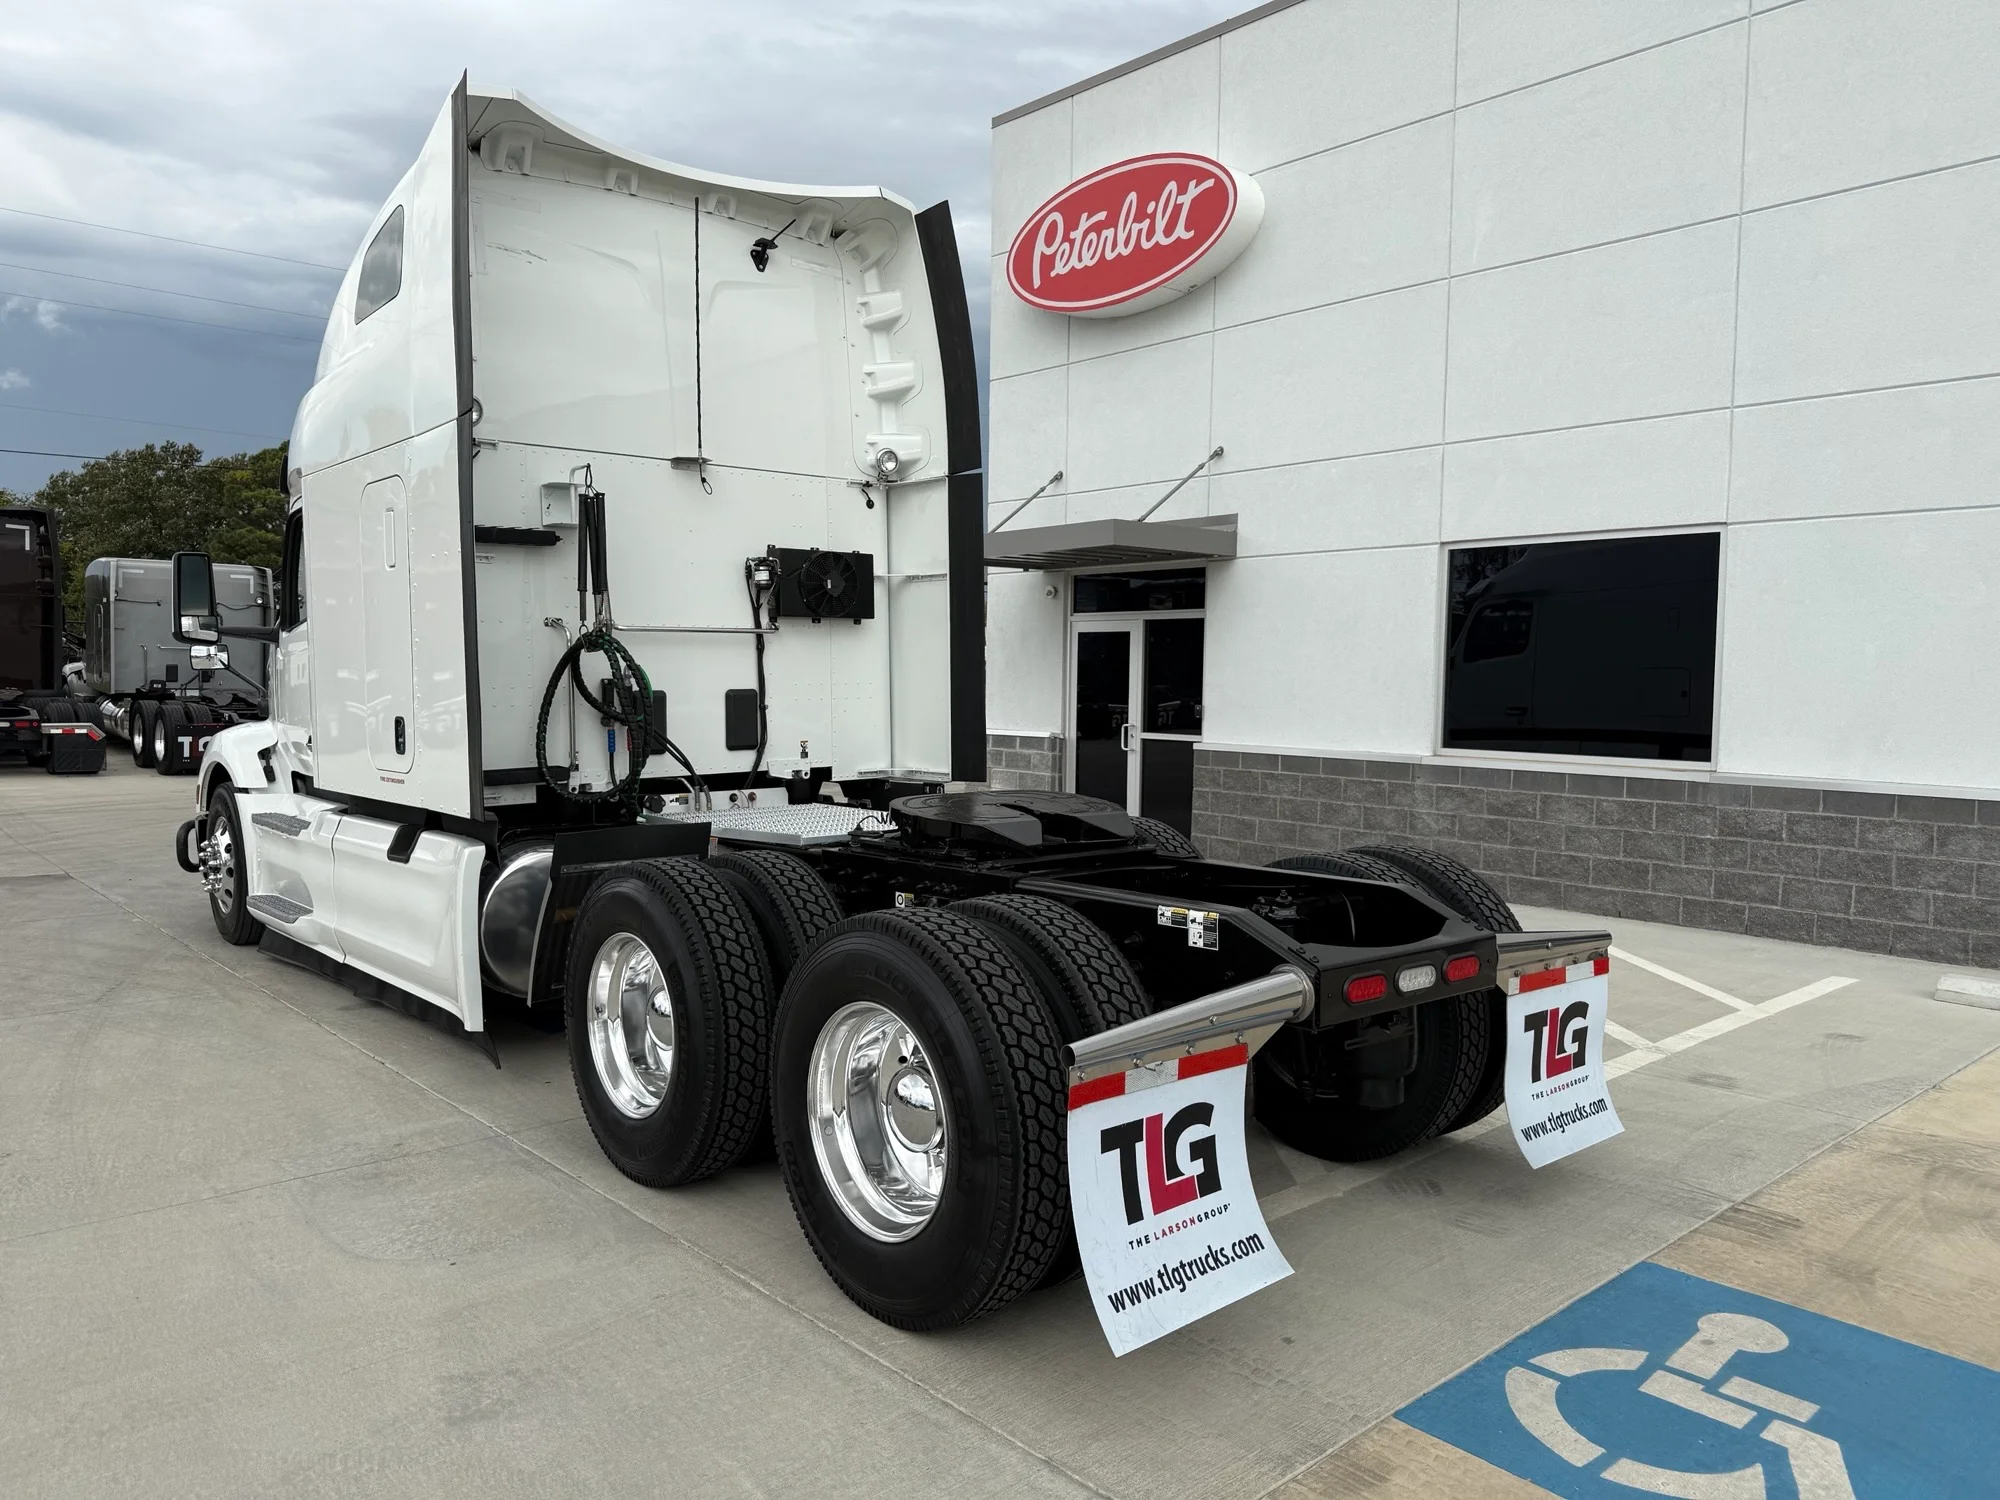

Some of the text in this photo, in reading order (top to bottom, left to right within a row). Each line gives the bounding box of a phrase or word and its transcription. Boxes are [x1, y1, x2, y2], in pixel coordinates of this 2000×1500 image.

[1032, 178, 1216, 289] Peterbilt
[1524, 1000, 1590, 1084] TLG
[1520, 1097, 1608, 1142] www.tlgtrucks.com
[1531, 1091, 1544, 1101] THE
[1100, 1101, 1222, 1226] TLG
[1107, 1232, 1265, 1314] www.tlgtrucks.com
[1128, 1234, 1151, 1250] THE
